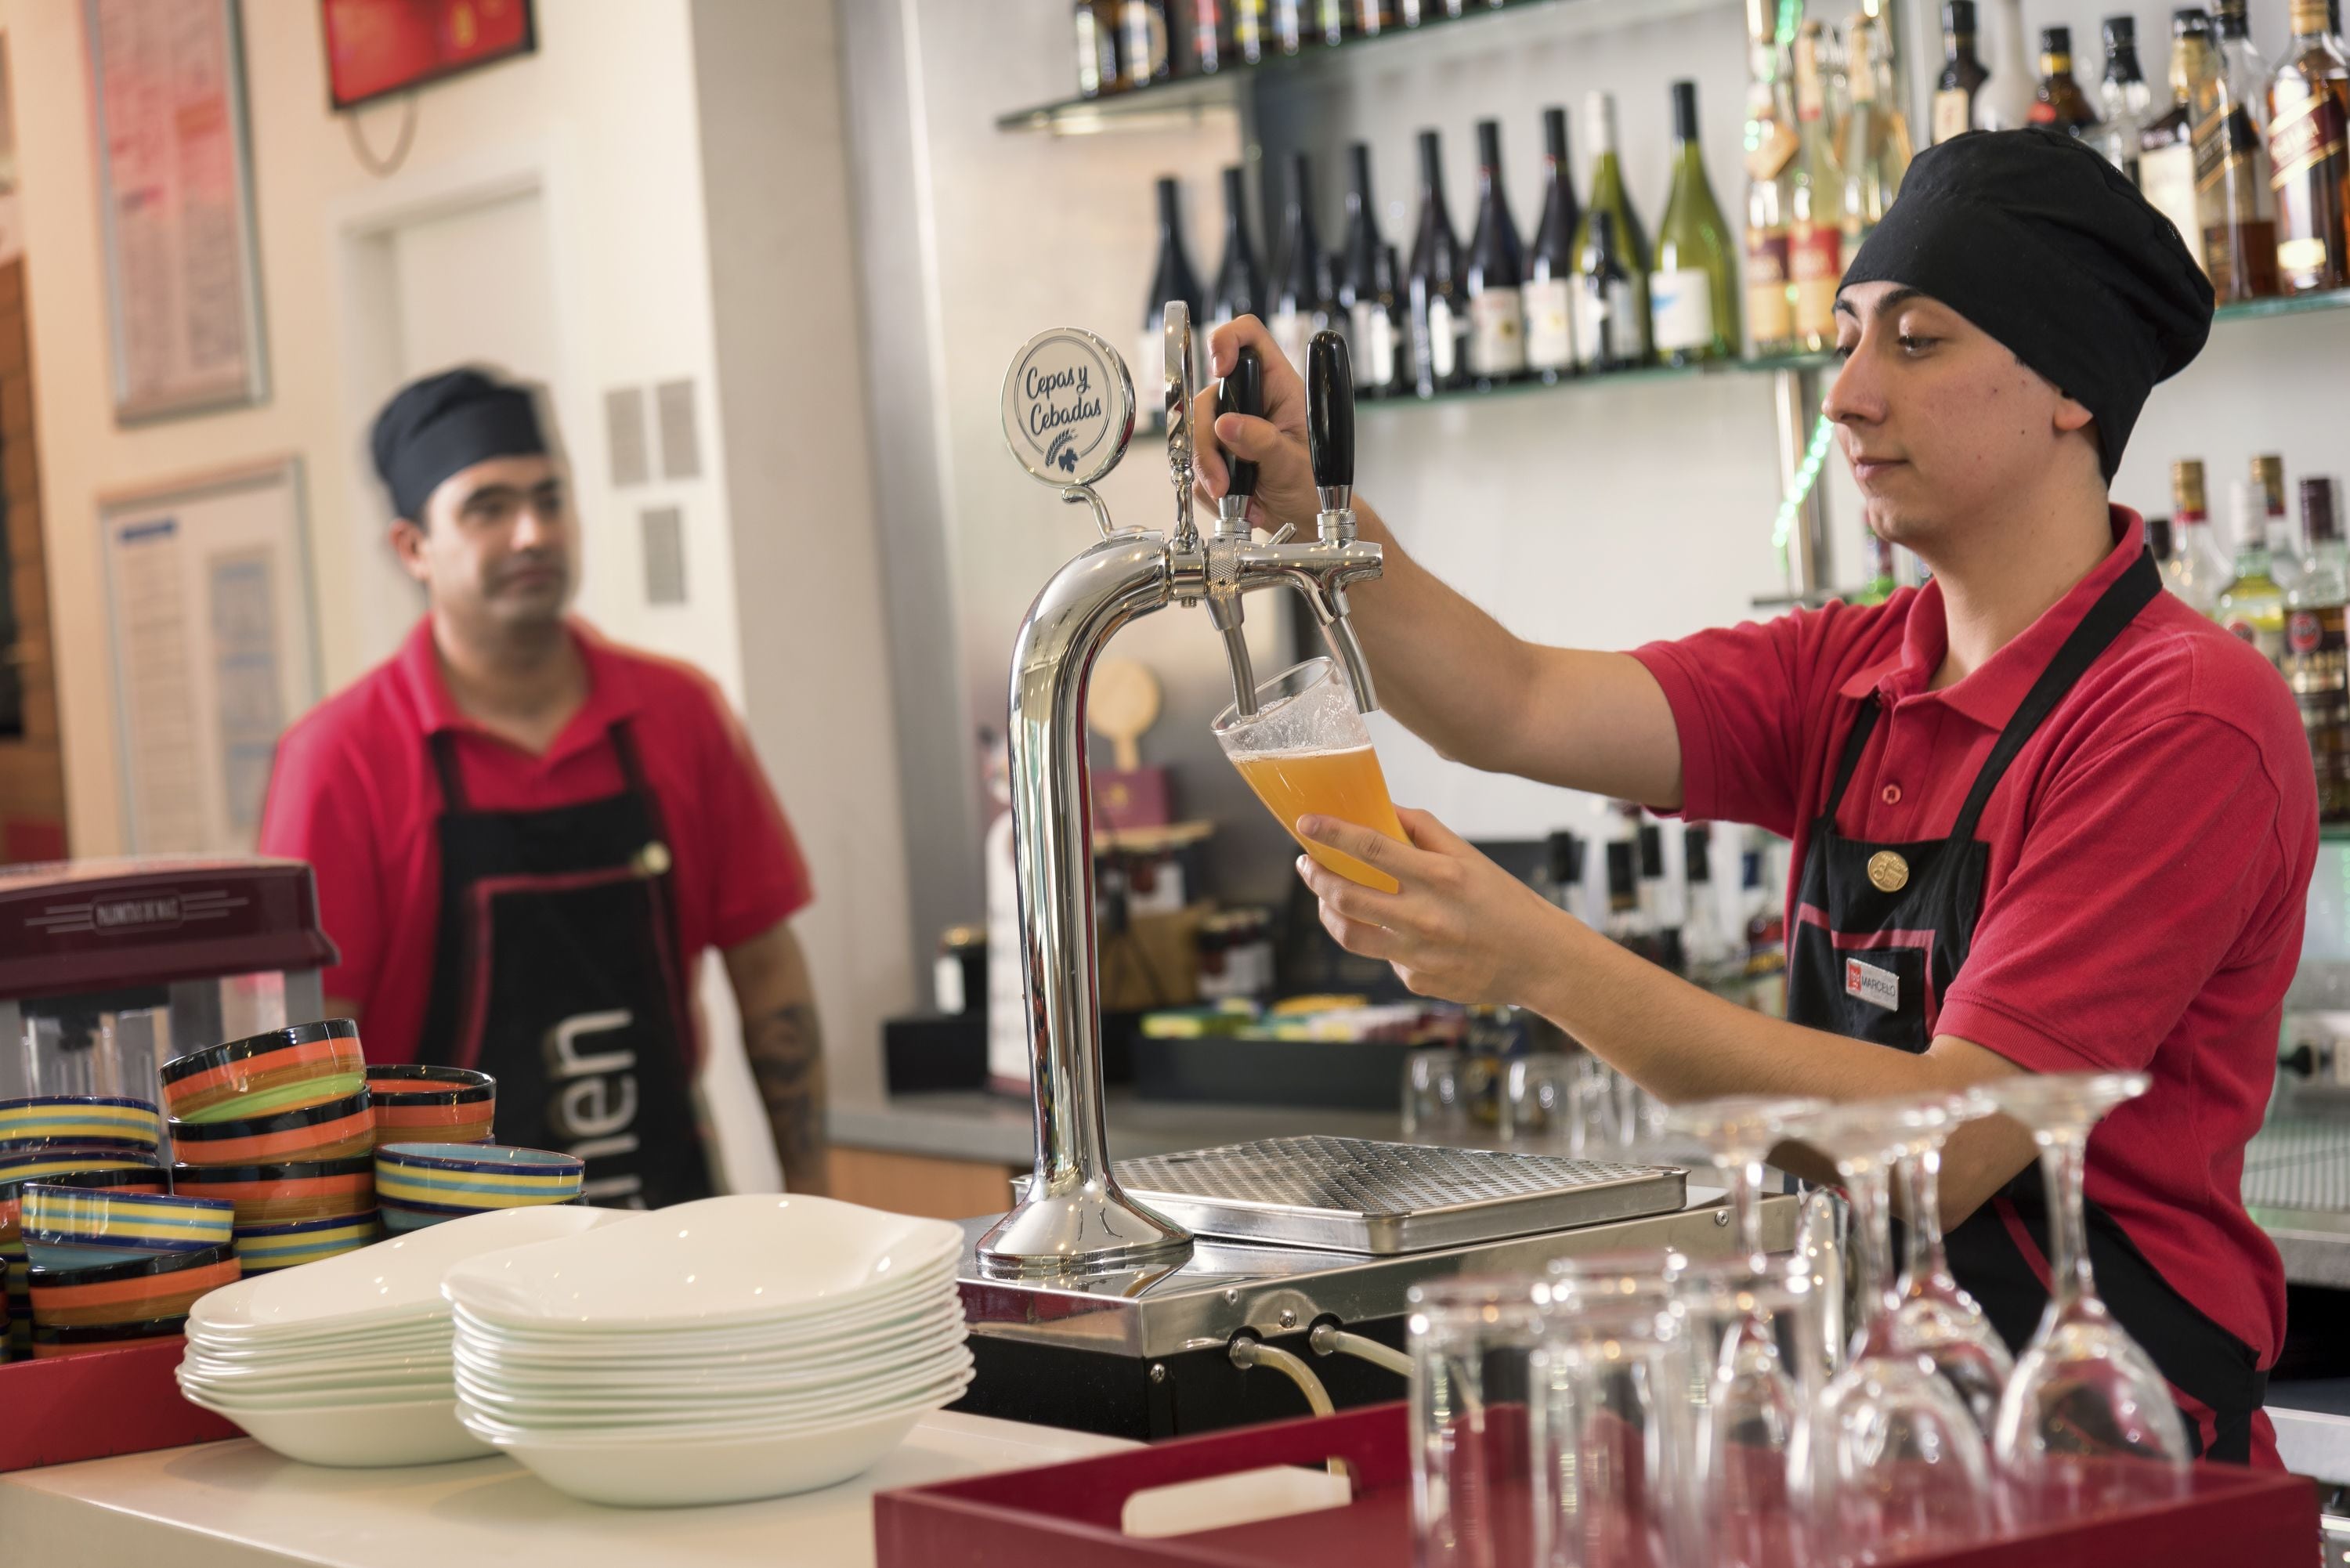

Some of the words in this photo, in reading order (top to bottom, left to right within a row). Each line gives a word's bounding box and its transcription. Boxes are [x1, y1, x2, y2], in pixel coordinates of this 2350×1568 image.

[1026, 366, 1075, 399] Cepas
[1076, 364, 1091, 395] y
[1029, 396, 1102, 435] Cebadas
[1861, 975, 1896, 997] MARCELO
